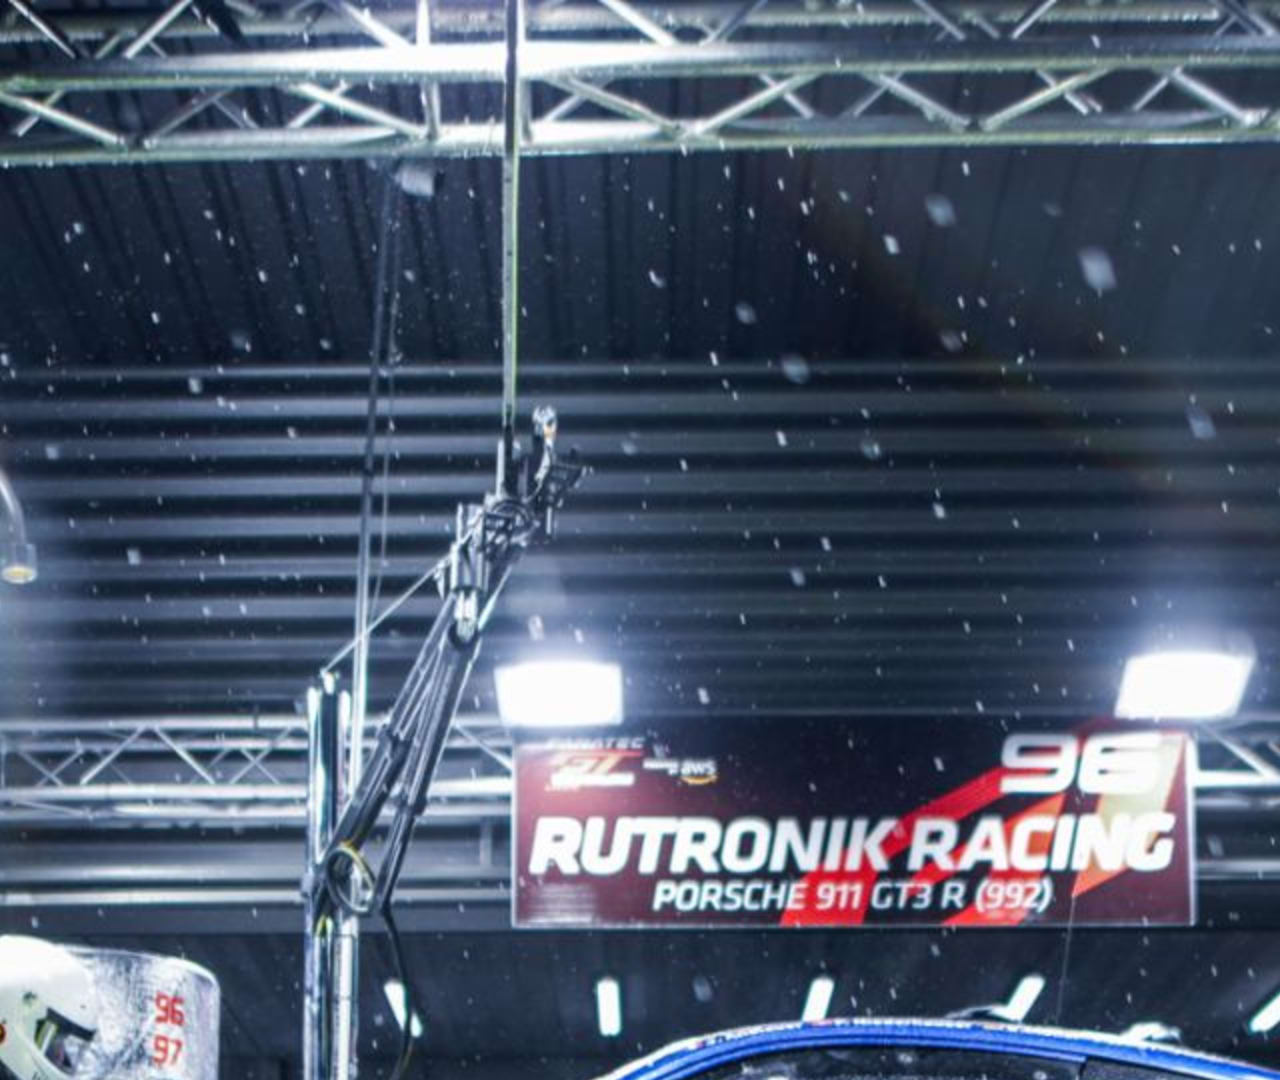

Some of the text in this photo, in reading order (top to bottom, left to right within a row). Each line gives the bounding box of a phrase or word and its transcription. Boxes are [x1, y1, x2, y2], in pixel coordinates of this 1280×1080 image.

[999, 732, 1163, 795] 96
[528, 812, 1176, 876] RUTRONIK RACING
[652, 877, 1053, 912] PORSCHE 911 GT3 R (992)
